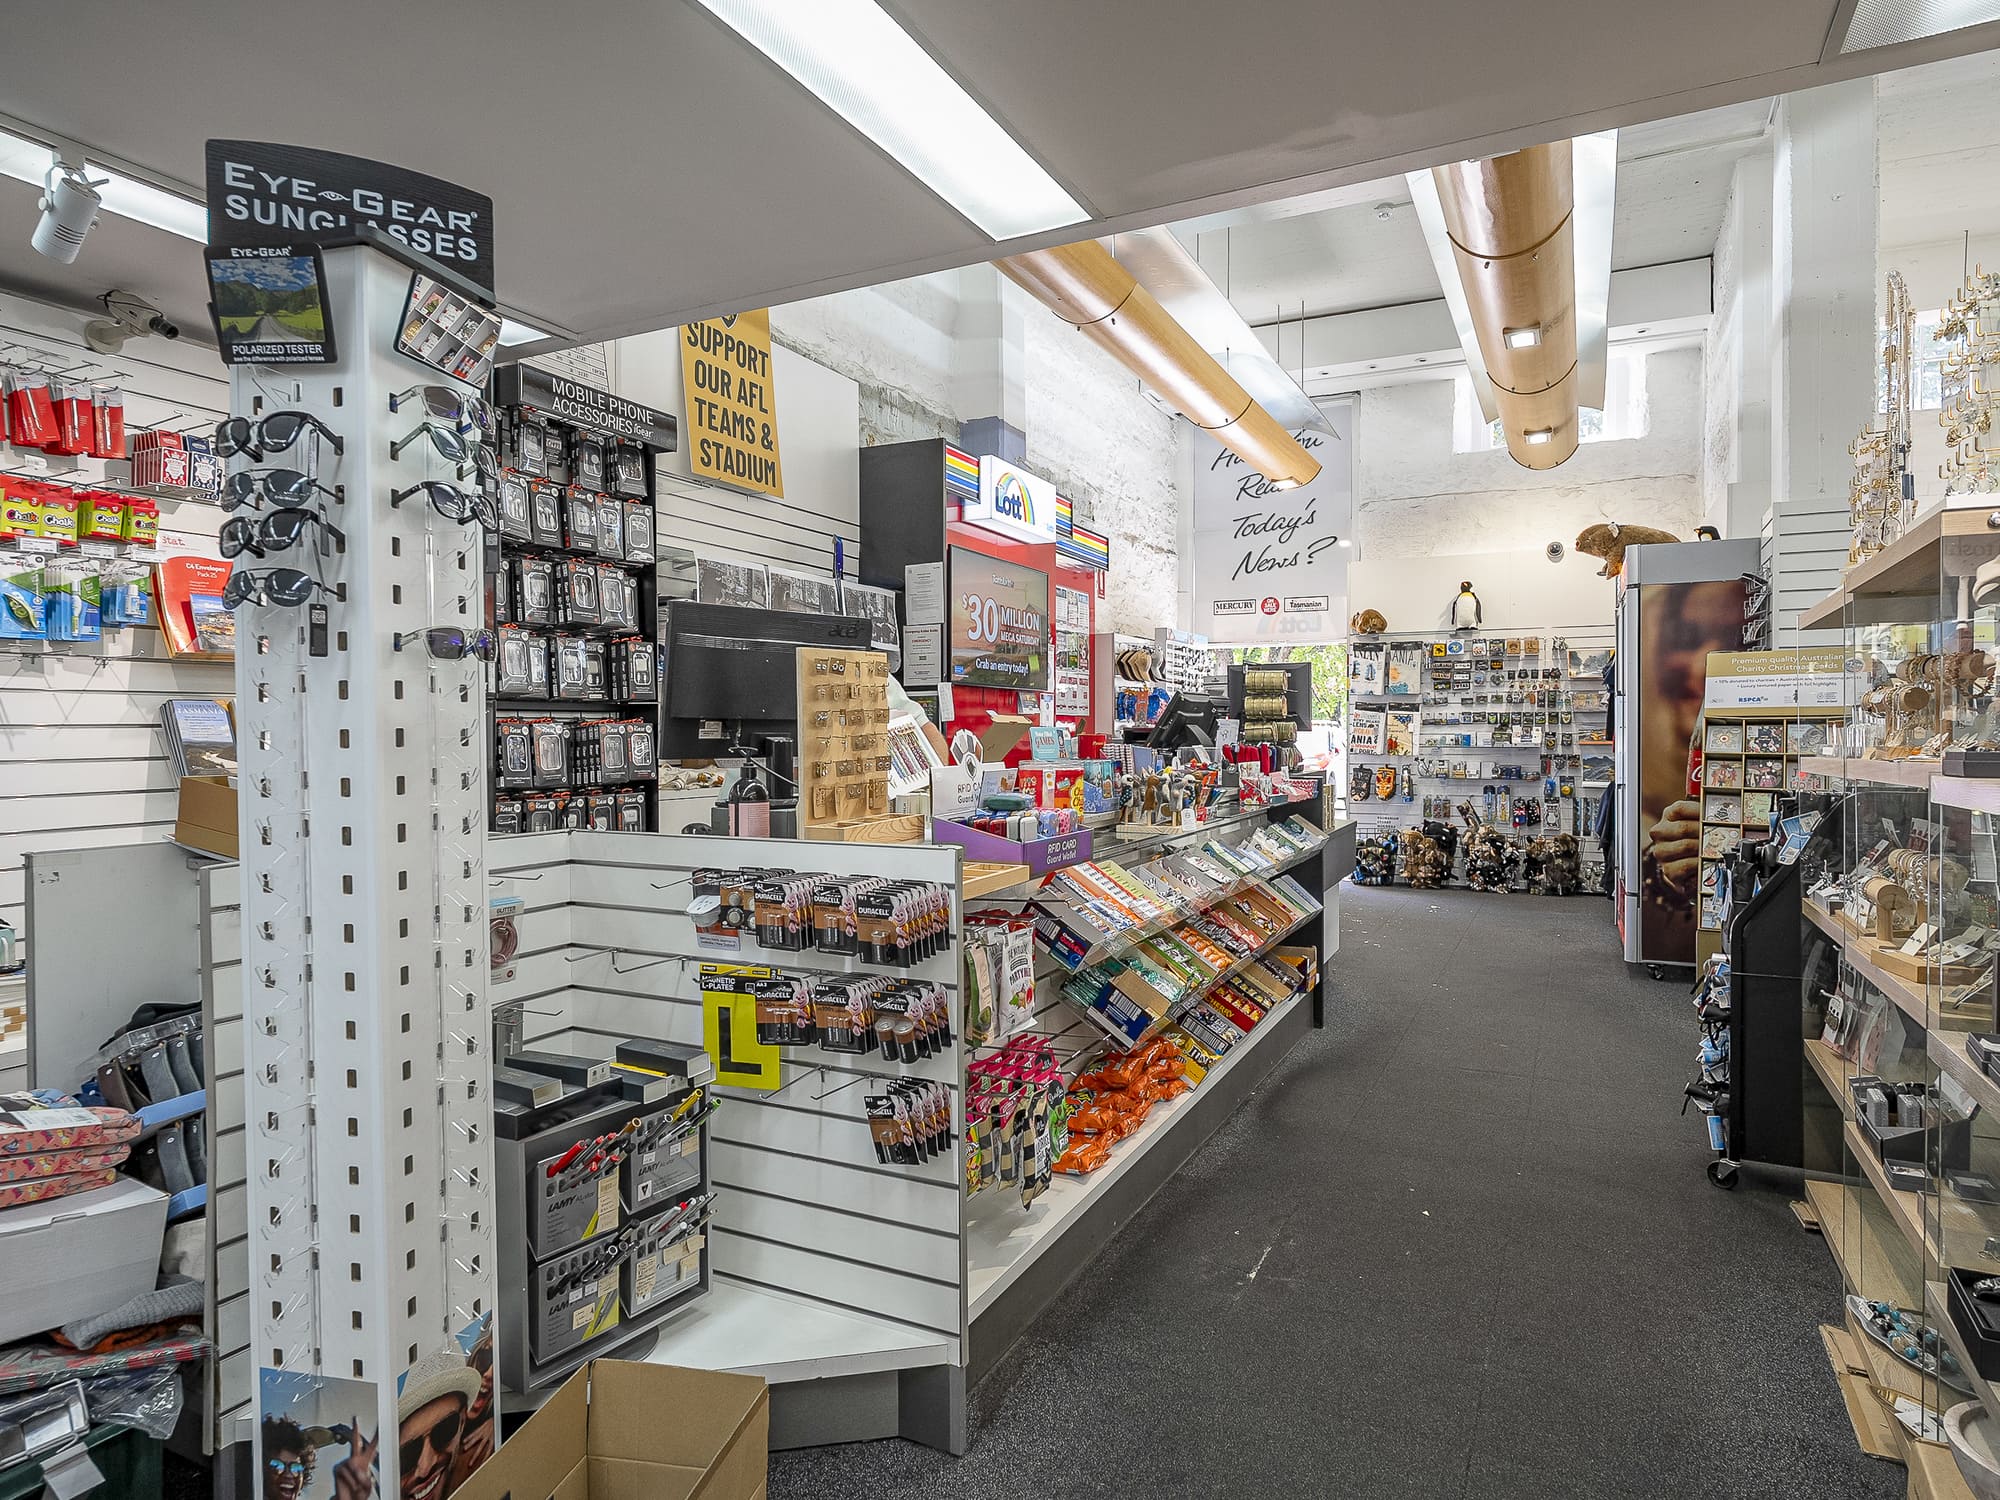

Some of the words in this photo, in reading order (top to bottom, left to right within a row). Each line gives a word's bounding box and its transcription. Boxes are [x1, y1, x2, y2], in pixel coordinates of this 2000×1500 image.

[232, 344, 285, 355] POLARIZED
[286, 344, 323, 354] TESTER
[686, 322, 769, 378] SUPPORT
[693, 359, 732, 399] OUR
[736, 376, 769, 414] AFL
[552, 377, 605, 409] MOBILE
[609, 400, 654, 426] PHONE
[551, 398, 633, 434] ACCESSORIES
[694, 397, 756, 442] TEAMS
[760, 422, 774, 452] &
[700, 438, 777, 488] STADIUM
[995, 486, 1022, 520] Lott
[6, 508, 39, 523] Chalk
[43, 514, 75, 529] Chalk
[95, 514, 120, 526] Chalk
[1232, 497, 1316, 544] Today's
[195, 564, 226, 573] Envelopes
[1216, 601, 1254, 611] MERCURY
[1290, 600, 1322, 609] Tasmanian
[962, 592, 999, 643] $30
[1001, 606, 1040, 631] MILLION
[1000, 631, 1015, 641] MEGA
[1015, 633, 1040, 646] SATURDAY
[976, 658, 989, 669] Grab
[998, 662, 1012, 674] entry
[1731, 657, 1768, 666] Premium
[1770, 657, 1797, 666] quality
[1800, 654, 1843, 664] Australian
[1736, 665, 1766, 674] Charity
[1768, 662, 1808, 672] Christmas
[957, 784, 972, 794] RFID
[957, 793, 974, 804] Guard
[1047, 843, 1061, 854] RFID
[1062, 839, 1077, 851] CARD
[1046, 854, 1062, 865] Guard
[1062, 851, 1077, 862] Wallet
[755, 893, 784, 902] DURACELL
[814, 896, 840, 904] DURACELL
[858, 907, 890, 916] DURACELL
[1009, 968, 1024, 986] PARTY
[702, 982, 734, 992] L-PLATES
[718, 1006, 762, 1076] L
[639, 1160, 659, 1176] LAMY
[547, 1195, 576, 1213] LAMY
